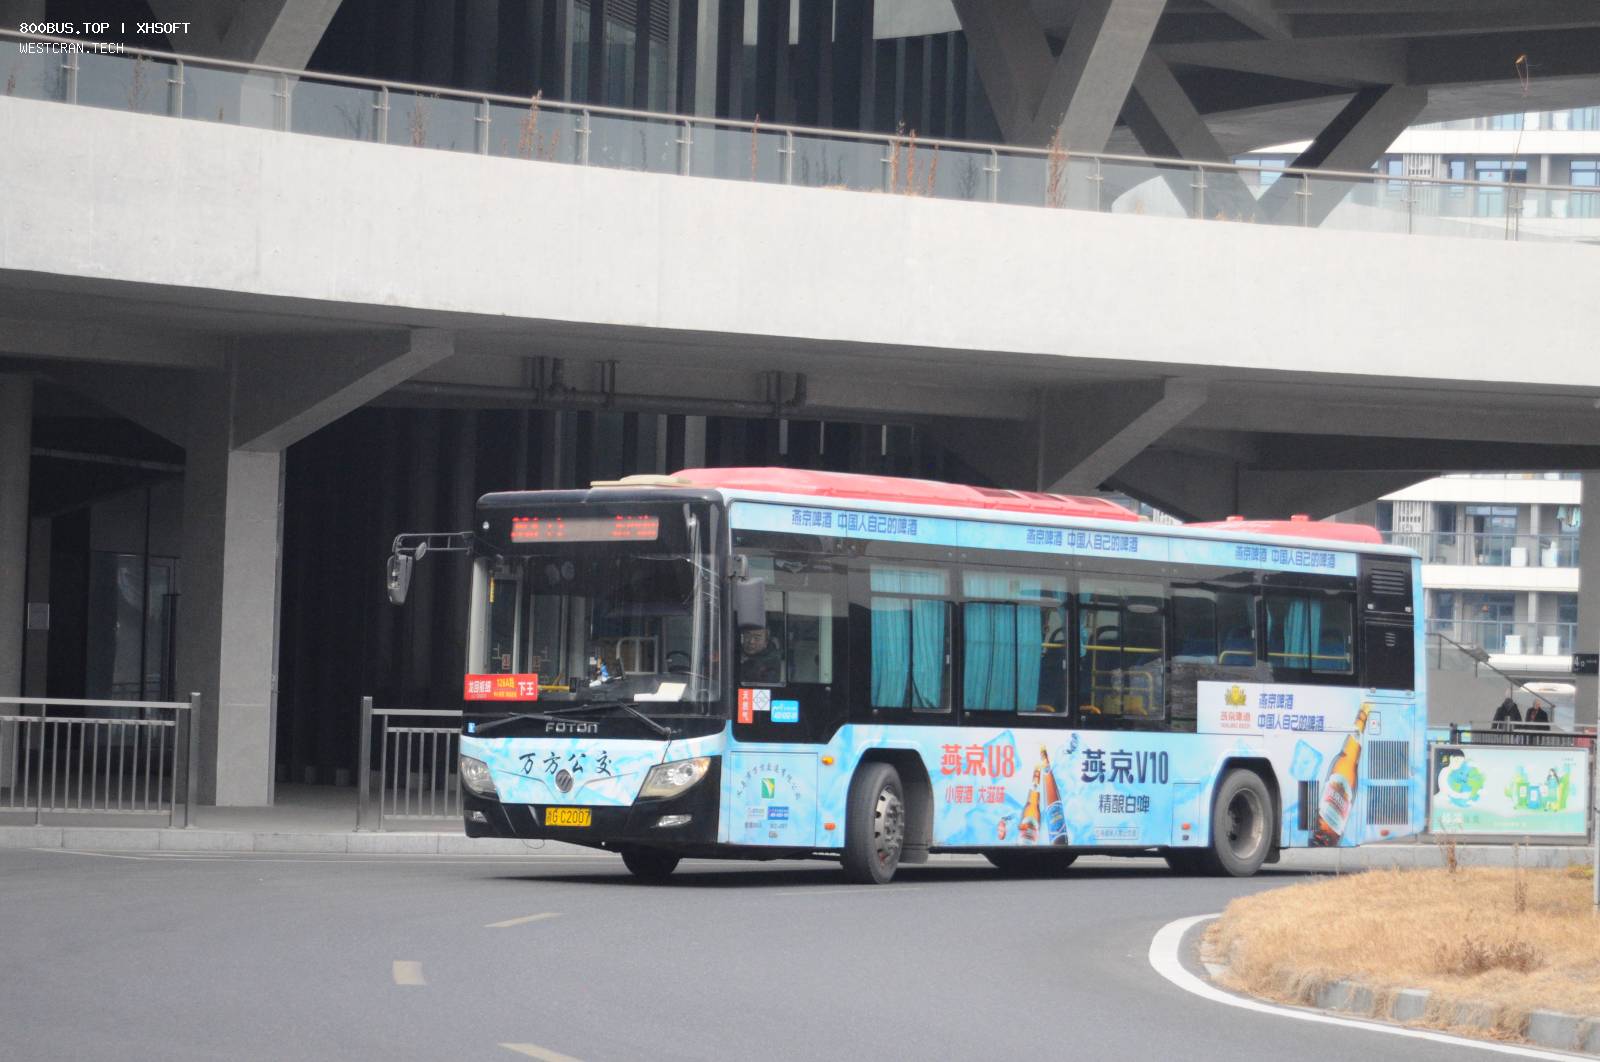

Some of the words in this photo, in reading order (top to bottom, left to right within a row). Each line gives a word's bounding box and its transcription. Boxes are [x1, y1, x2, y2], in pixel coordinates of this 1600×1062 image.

[792, 509, 832, 529] 燕京啤酒
[837, 511, 918, 536] 中国人自己的啤酒
[1066, 529, 1138, 553] 中国人自己的啤酒
[1271, 549, 1336, 569] 中国人自己的啤酒
[1259, 693, 1294, 710] 燕京啤酒
[545, 722, 598, 733] FOTON
[1257, 713, 1325, 732] 中国人自己的啤酒
[519, 750, 612, 777] 万方公交
[940, 743, 1015, 778] 燕京U8
[1081, 748, 1169, 785] 燕京V10
[1098, 793, 1150, 815] 精酿白啤
